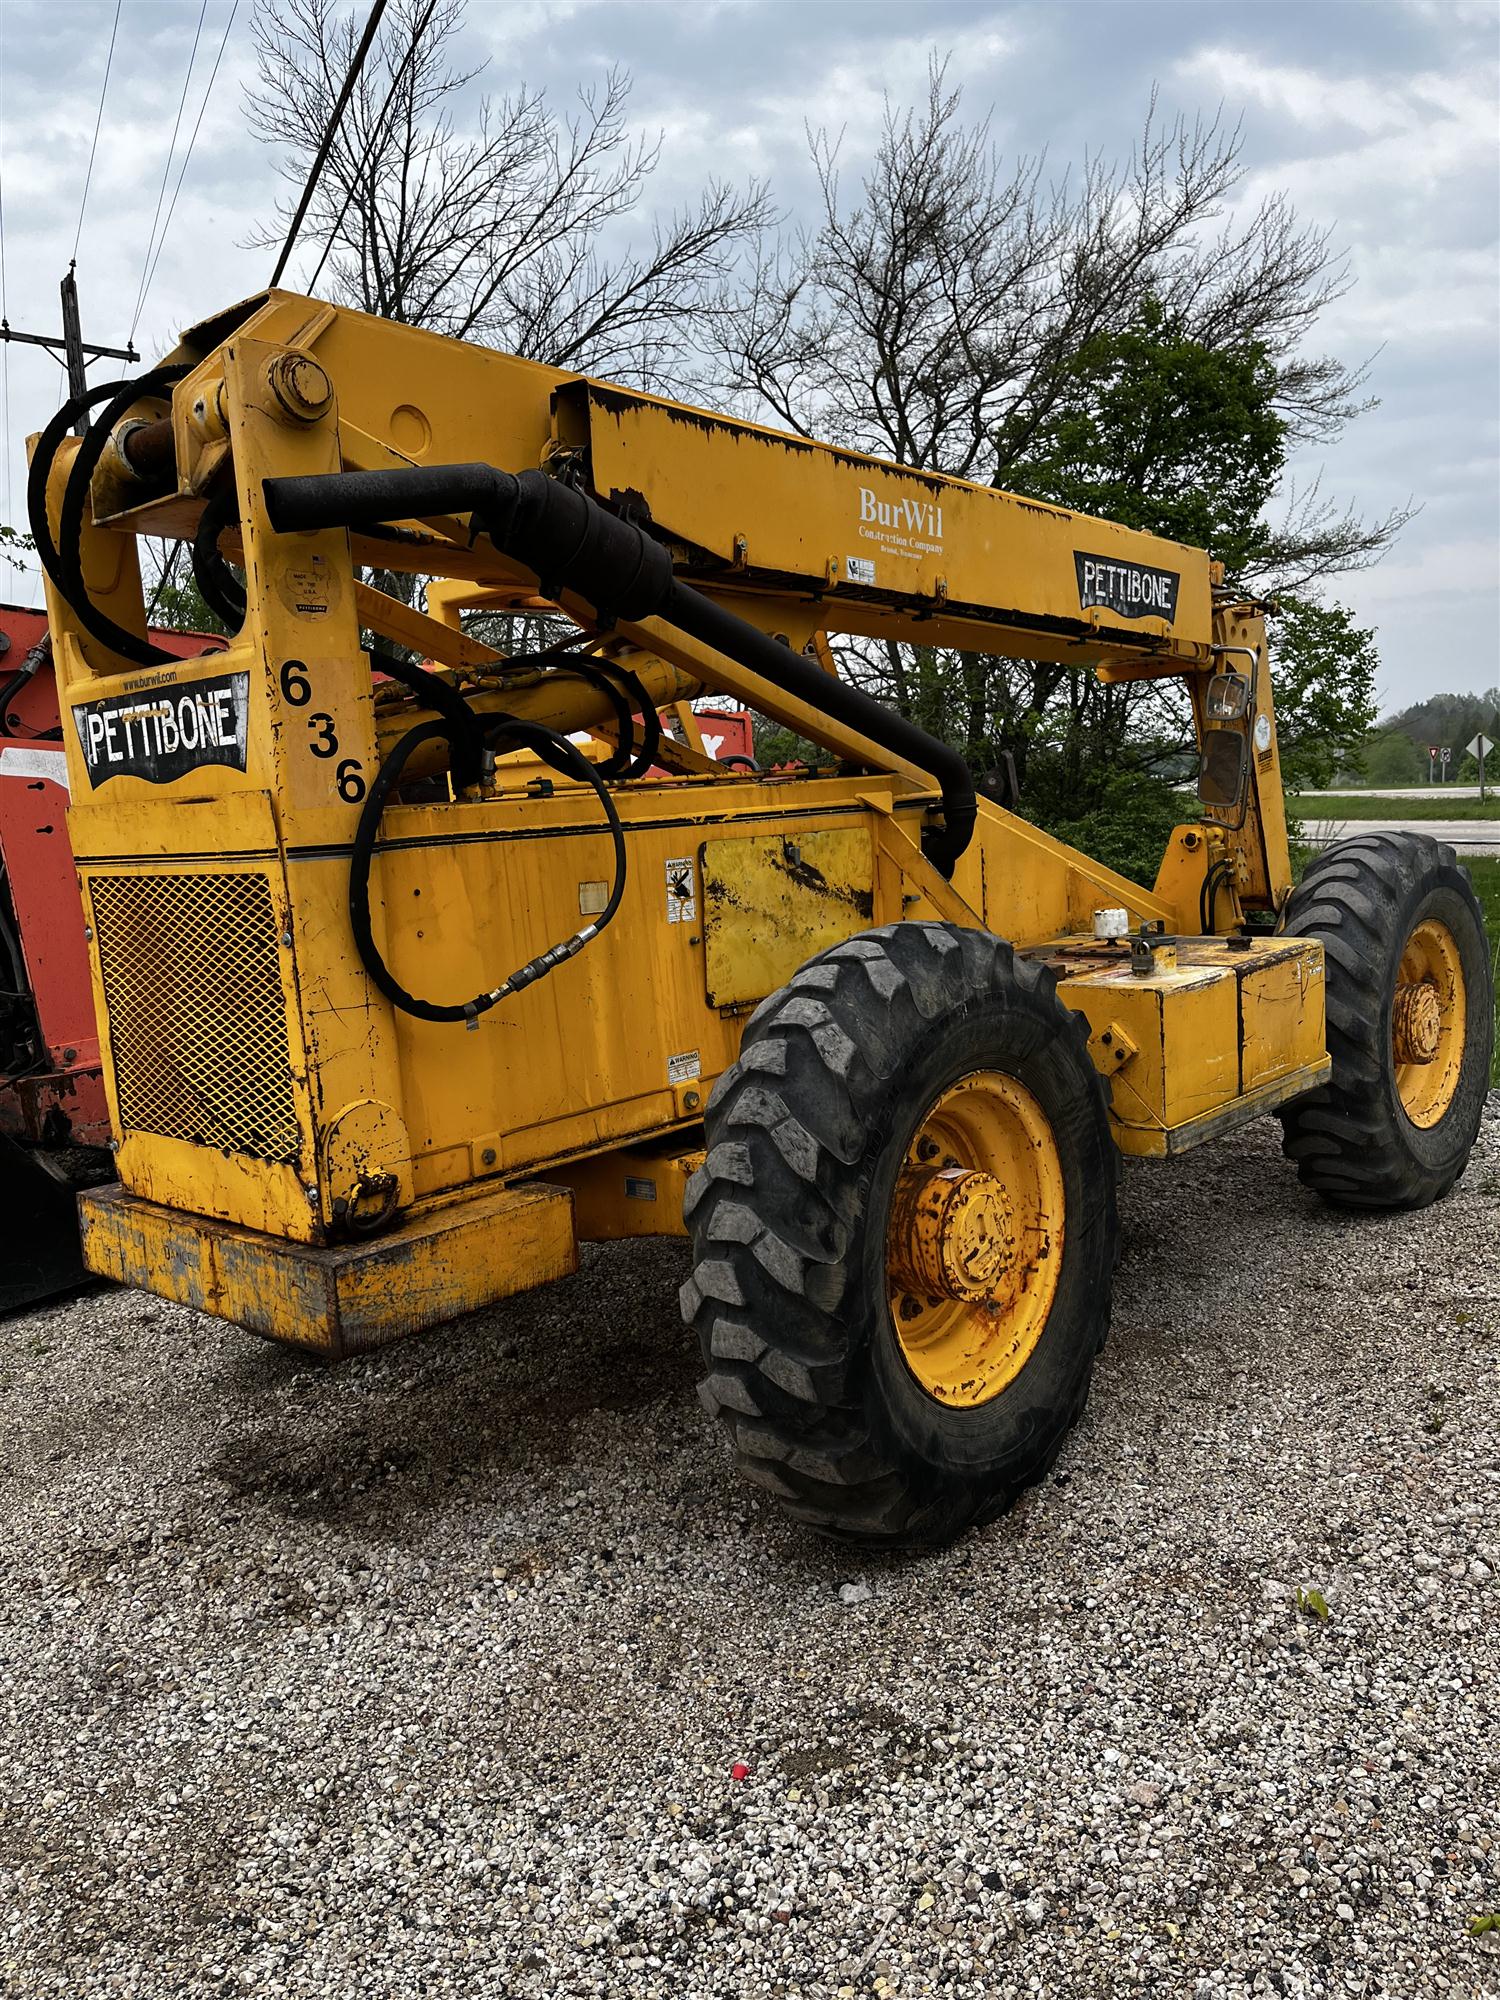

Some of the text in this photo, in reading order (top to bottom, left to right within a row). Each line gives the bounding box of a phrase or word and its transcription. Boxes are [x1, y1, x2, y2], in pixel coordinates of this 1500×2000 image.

[858, 487, 944, 538] BurWil
[909, 537, 944, 556] Company
[1084, 560, 1172, 609] PETTIBONE
[88, 688, 237, 764] PETTIBONE
[675, 1052, 698, 1063] WARNING
